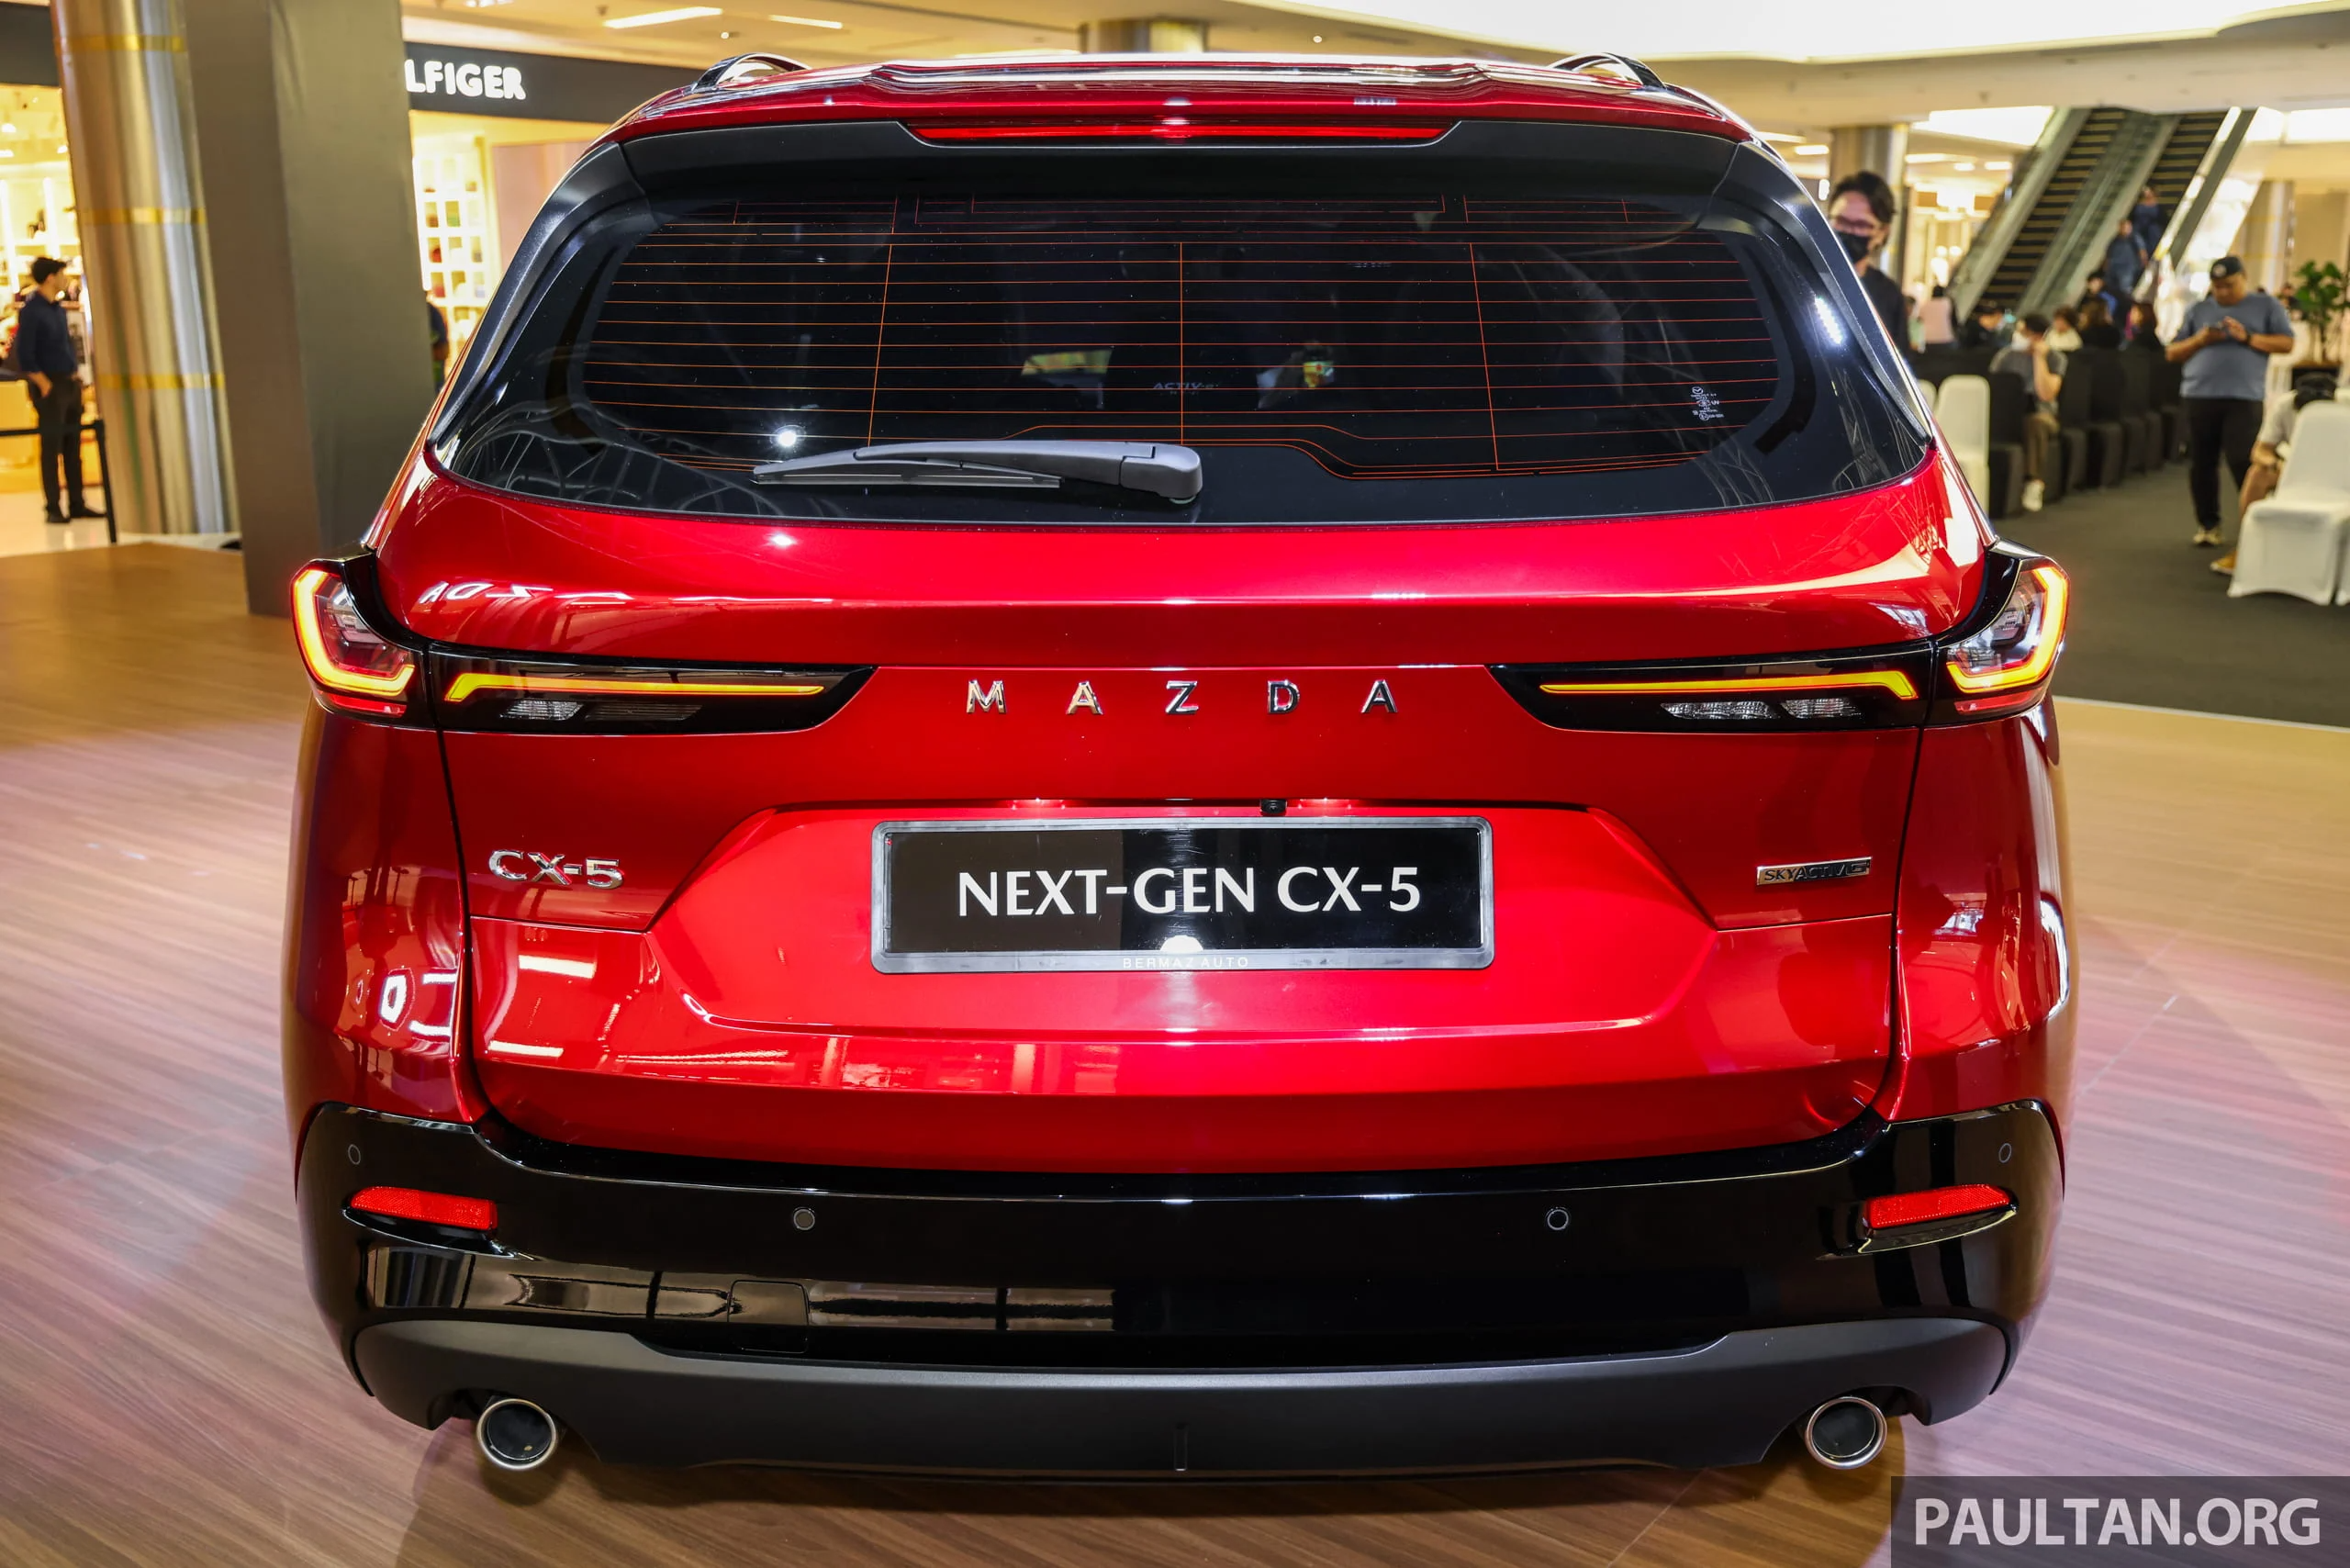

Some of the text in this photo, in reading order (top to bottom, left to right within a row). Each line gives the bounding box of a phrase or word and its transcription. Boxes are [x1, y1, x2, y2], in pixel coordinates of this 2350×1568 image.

[404, 59, 526, 100] LFIGER
[966, 678, 1398, 715] MAZDA
[488, 849, 624, 890] CX-5
[958, 866, 1421, 916] NEXT-GEN CX-5
[1123, 957, 1248, 969] BERMAZ AUTO
